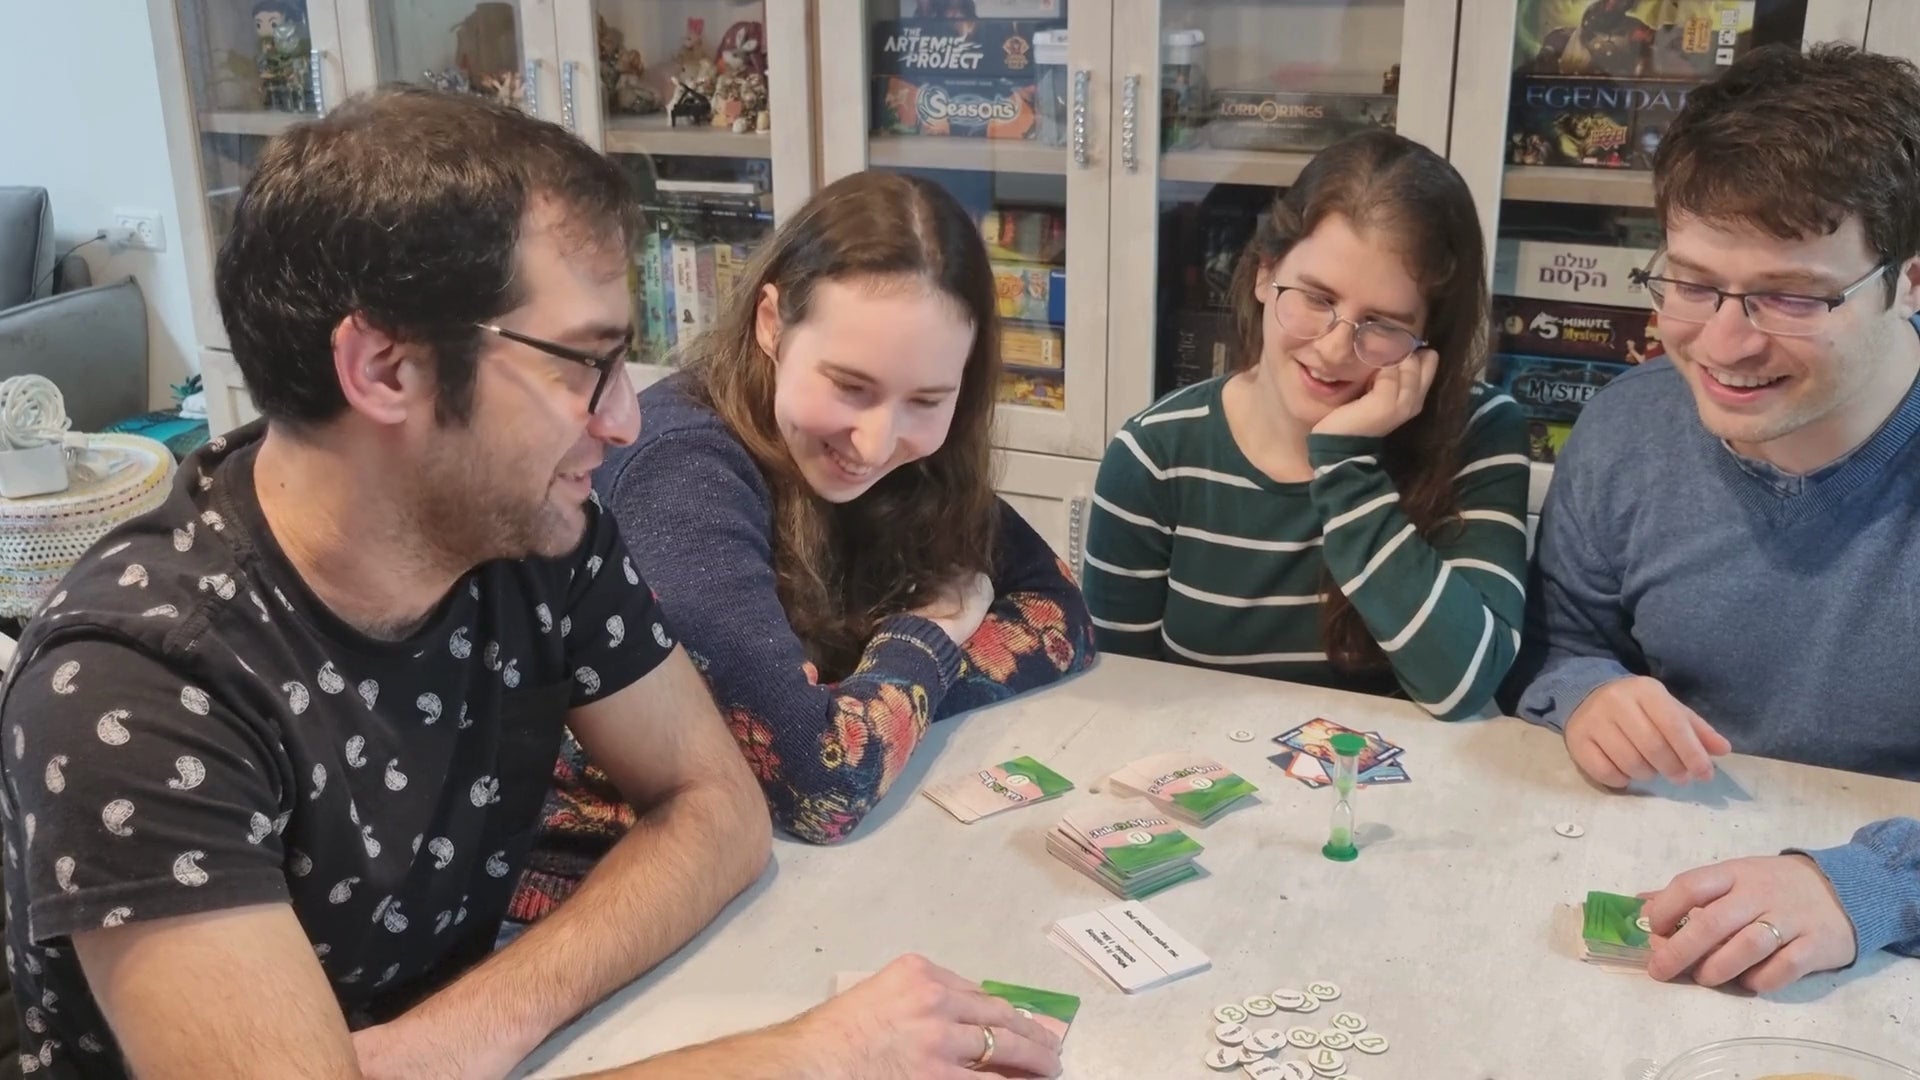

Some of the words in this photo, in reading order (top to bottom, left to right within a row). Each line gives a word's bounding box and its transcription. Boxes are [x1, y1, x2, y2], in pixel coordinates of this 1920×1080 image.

[903, 27, 921, 36] THE
[900, 46, 984, 69] PROJECT
[928, 92, 1015, 120] Seasons
[1220, 103, 1258, 118] LORD
[1276, 104, 1324, 119] RINGS
[1554, 252, 1598, 270] עולם
[1539, 267, 1608, 292] הקסם
[1562, 326, 1609, 345] Mystery
[1085, 928, 1106, 946] raining
[1123, 909, 1138, 920] Sad
[1134, 918, 1154, 937] movies
[1152, 934, 1170, 950] make
[1112, 952, 1128, 969] When
[1311, 984, 1335, 996] 3
[1336, 1014, 1361, 1029] 2
[1292, 1030, 1317, 1044] 2
[1324, 1033, 1348, 1047] 3
[1359, 1037, 1385, 1048] 1
[1318, 1049, 1335, 1065] 1
